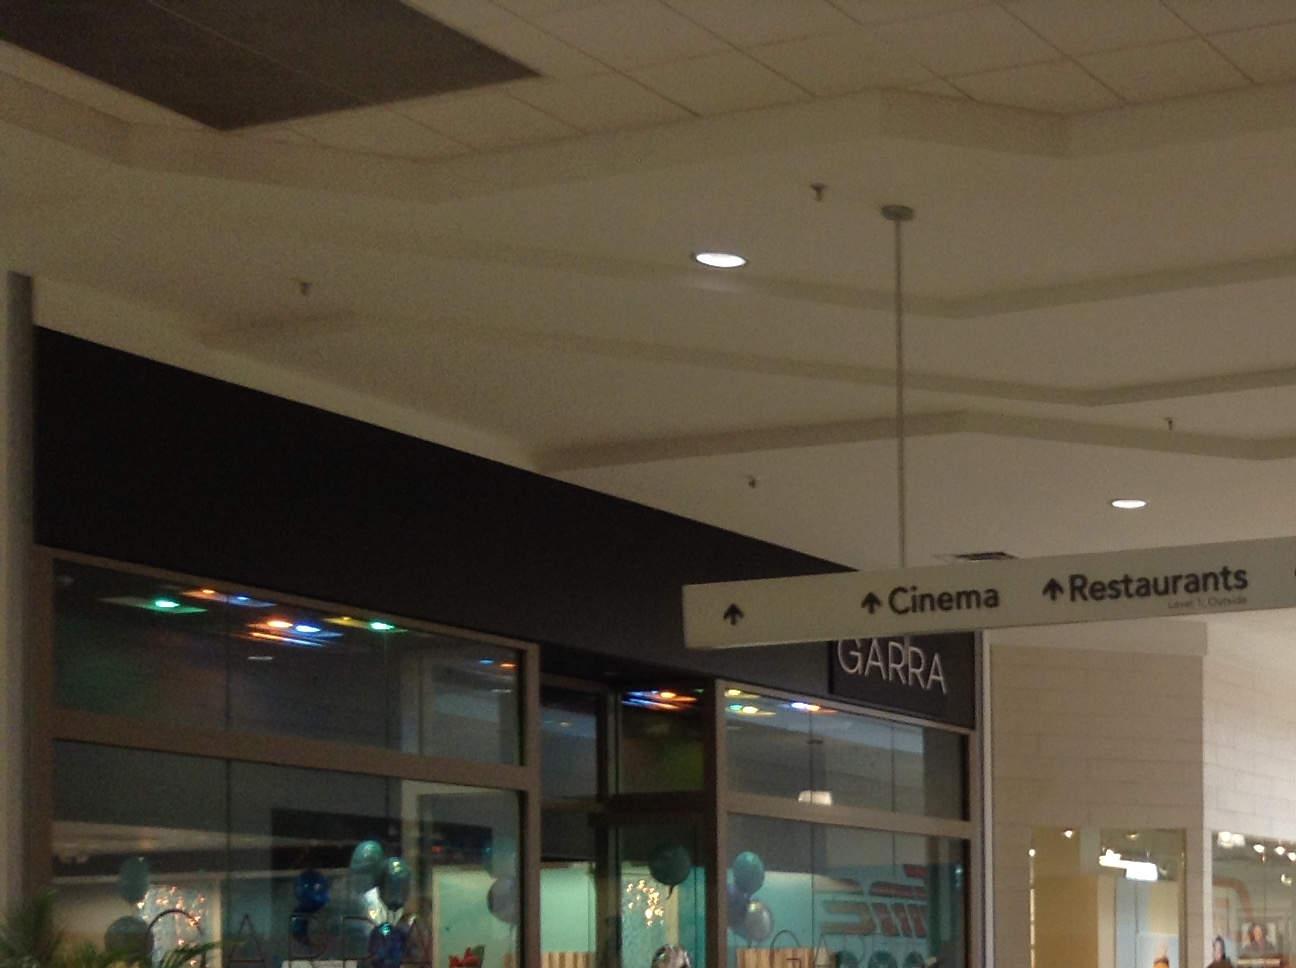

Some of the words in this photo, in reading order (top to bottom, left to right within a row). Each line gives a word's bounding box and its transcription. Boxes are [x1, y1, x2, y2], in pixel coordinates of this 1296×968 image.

[887, 585, 1000, 615] Cinema
[1068, 565, 1249, 603] Restaurants
[837, 637, 948, 695] GARRA
